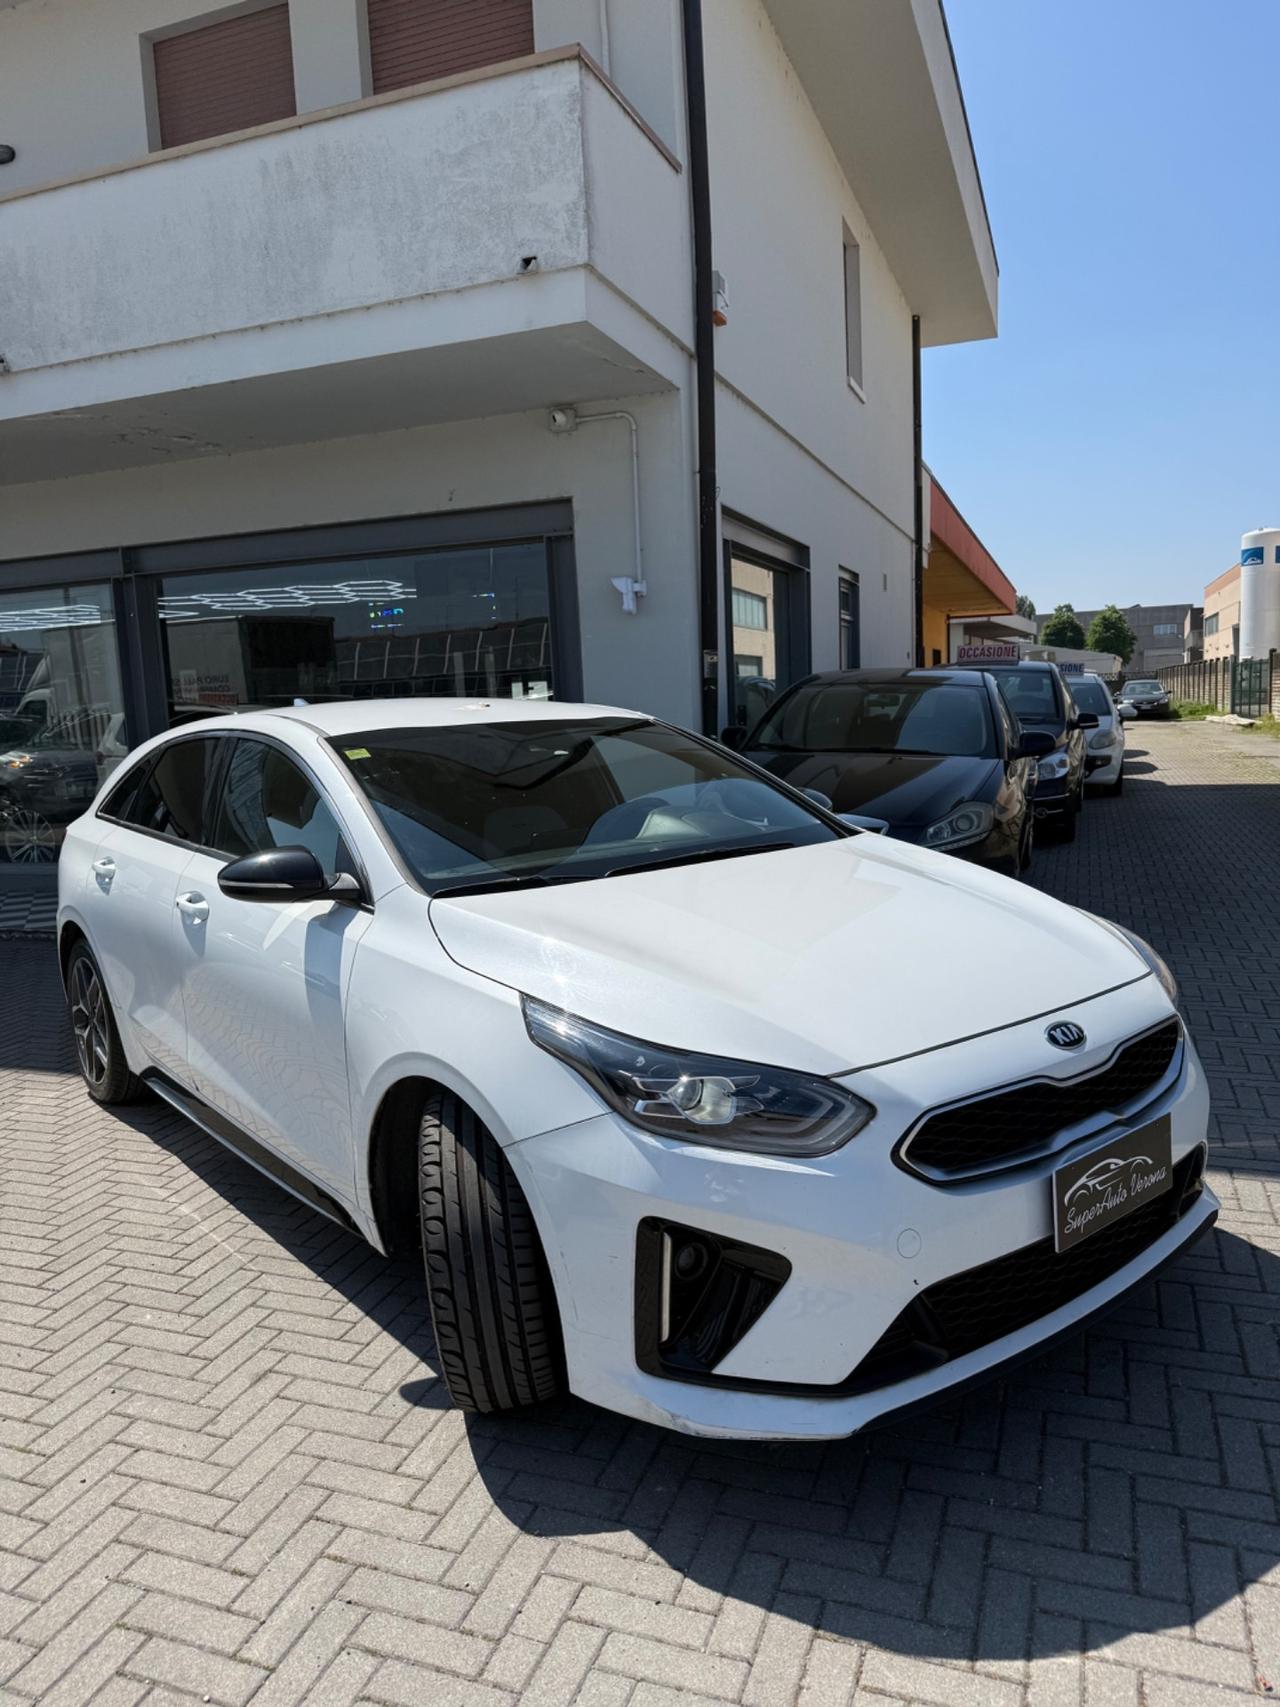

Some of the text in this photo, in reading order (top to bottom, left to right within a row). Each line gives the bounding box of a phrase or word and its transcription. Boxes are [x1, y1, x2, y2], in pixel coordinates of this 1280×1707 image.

[959, 646, 1016, 658] OCCASIONE
[1050, 1024, 1084, 1045] KIA
[1130, 1166, 1168, 1196] Verona
